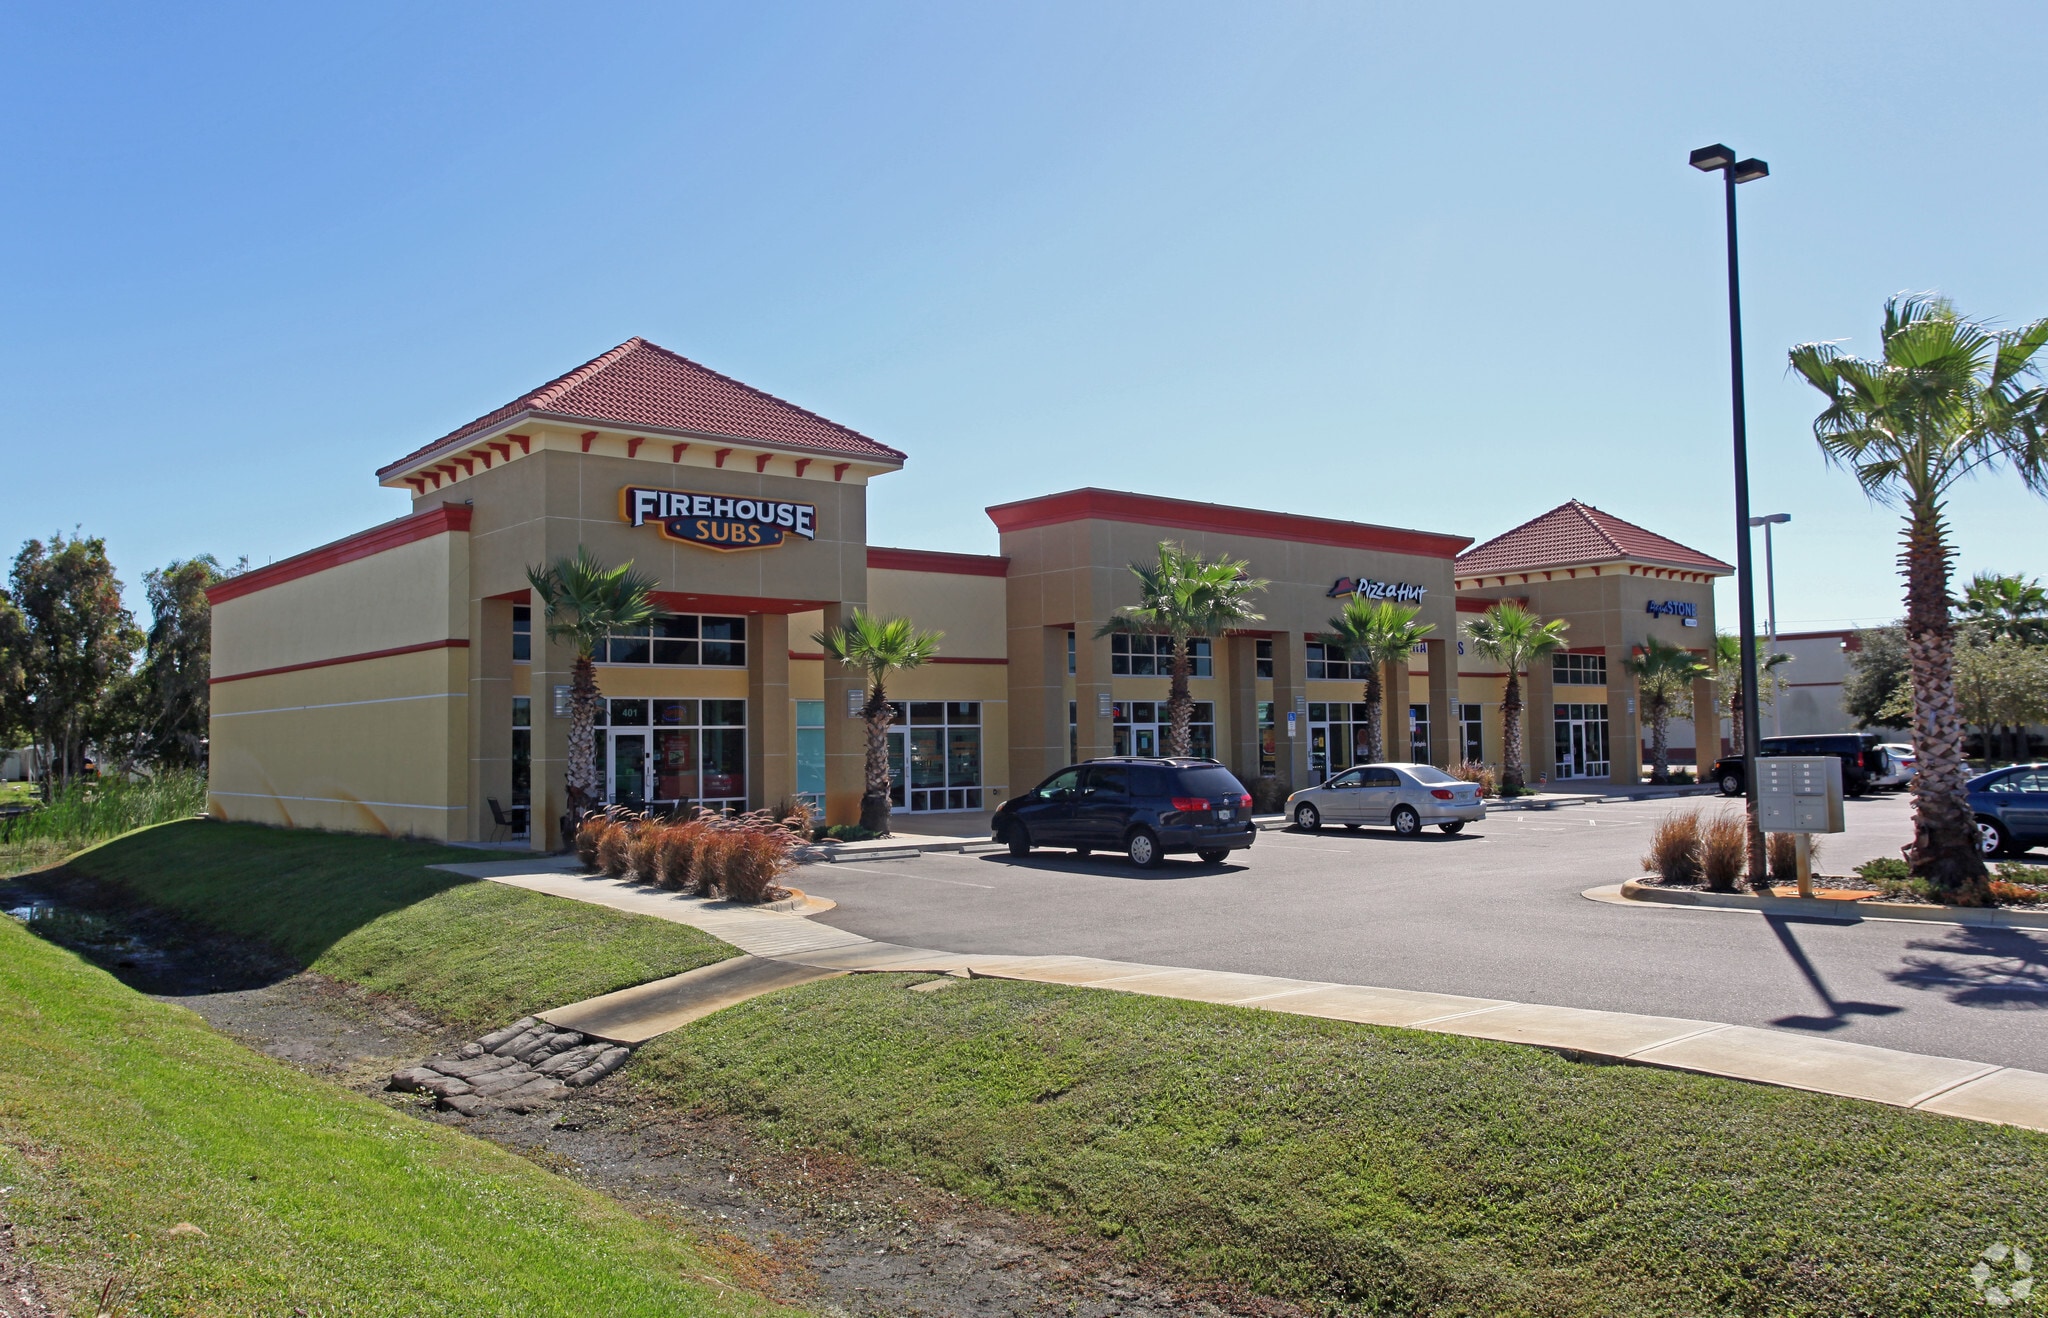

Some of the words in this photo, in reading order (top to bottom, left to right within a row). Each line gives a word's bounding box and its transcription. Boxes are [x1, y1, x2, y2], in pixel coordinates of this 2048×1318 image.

[633, 489, 815, 540] FIREHOUSE
[696, 520, 761, 544] SUBS
[622, 709, 638, 718] 401
